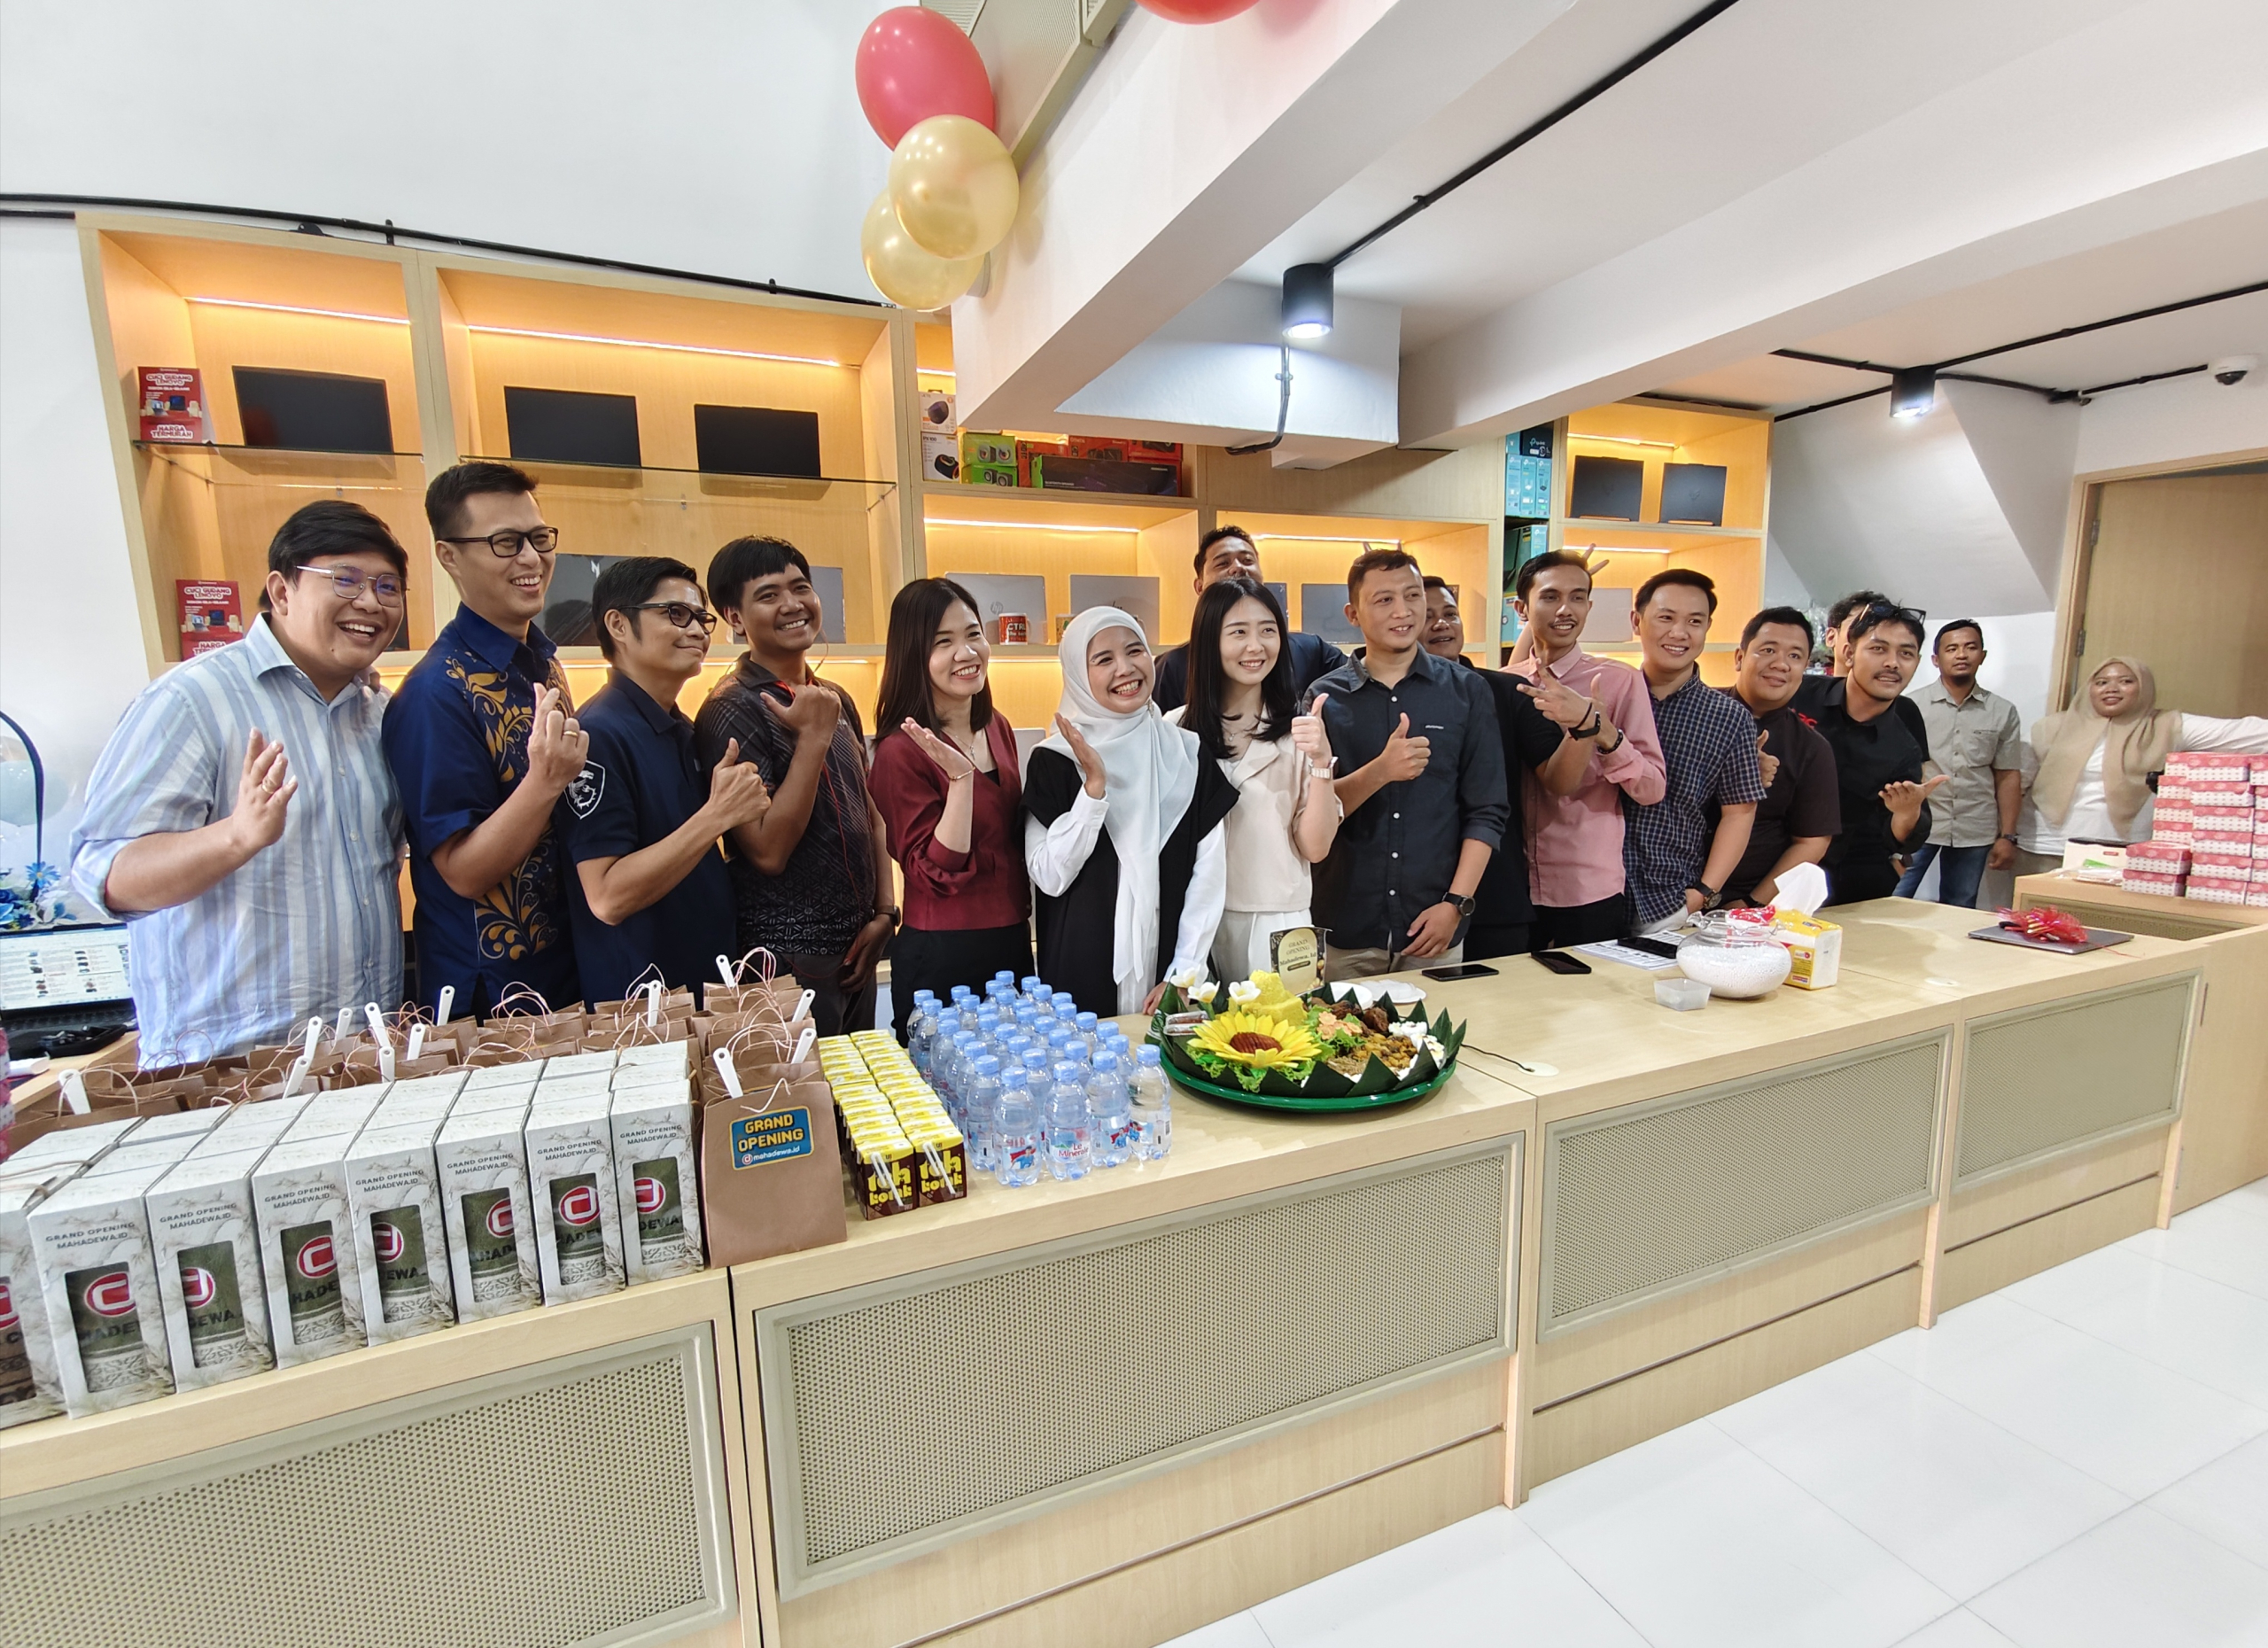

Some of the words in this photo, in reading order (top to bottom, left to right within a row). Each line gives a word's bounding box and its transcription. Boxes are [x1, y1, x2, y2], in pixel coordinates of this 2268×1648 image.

[1286, 945, 1310, 955] OPENING
[620, 1131, 648, 1139] GRAND
[648, 1124, 682, 1135] OPENING
[745, 1114, 794, 1134] GRAND
[537, 1146, 565, 1154] GRAND
[566, 1139, 602, 1150] OPENING
[627, 1131, 677, 1146] MAHADEWA.ID
[738, 1128, 804, 1152] OPENING
[545, 1147, 597, 1161] MAHADEWA.ID
[753, 1145, 801, 1161] mahadewa.id
[1058, 1147, 1089, 1157] Minerale
[447, 1159, 476, 1170] GRAND
[478, 1153, 514, 1164] OPENING
[454, 1162, 509, 1176] MAHADEWA.ID
[355, 1176, 384, 1185] GRAND
[386, 1169, 424, 1181] OPENING
[264, 1191, 295, 1202] GRAND
[297, 1183, 336, 1195] OPENING
[363, 1178, 419, 1193] MAHADEWA.ID
[273, 1193, 330, 1209] MAHADEWA.ID
[159, 1211, 194, 1223] GRAND
[196, 1202, 237, 1216] OPENING
[169, 1212, 231, 1230] MAHADEWA.ID
[45, 1231, 84, 1241] GRAND
[87, 1222, 135, 1235] OPENING
[57, 1232, 128, 1249] MAHADEWA.ID
